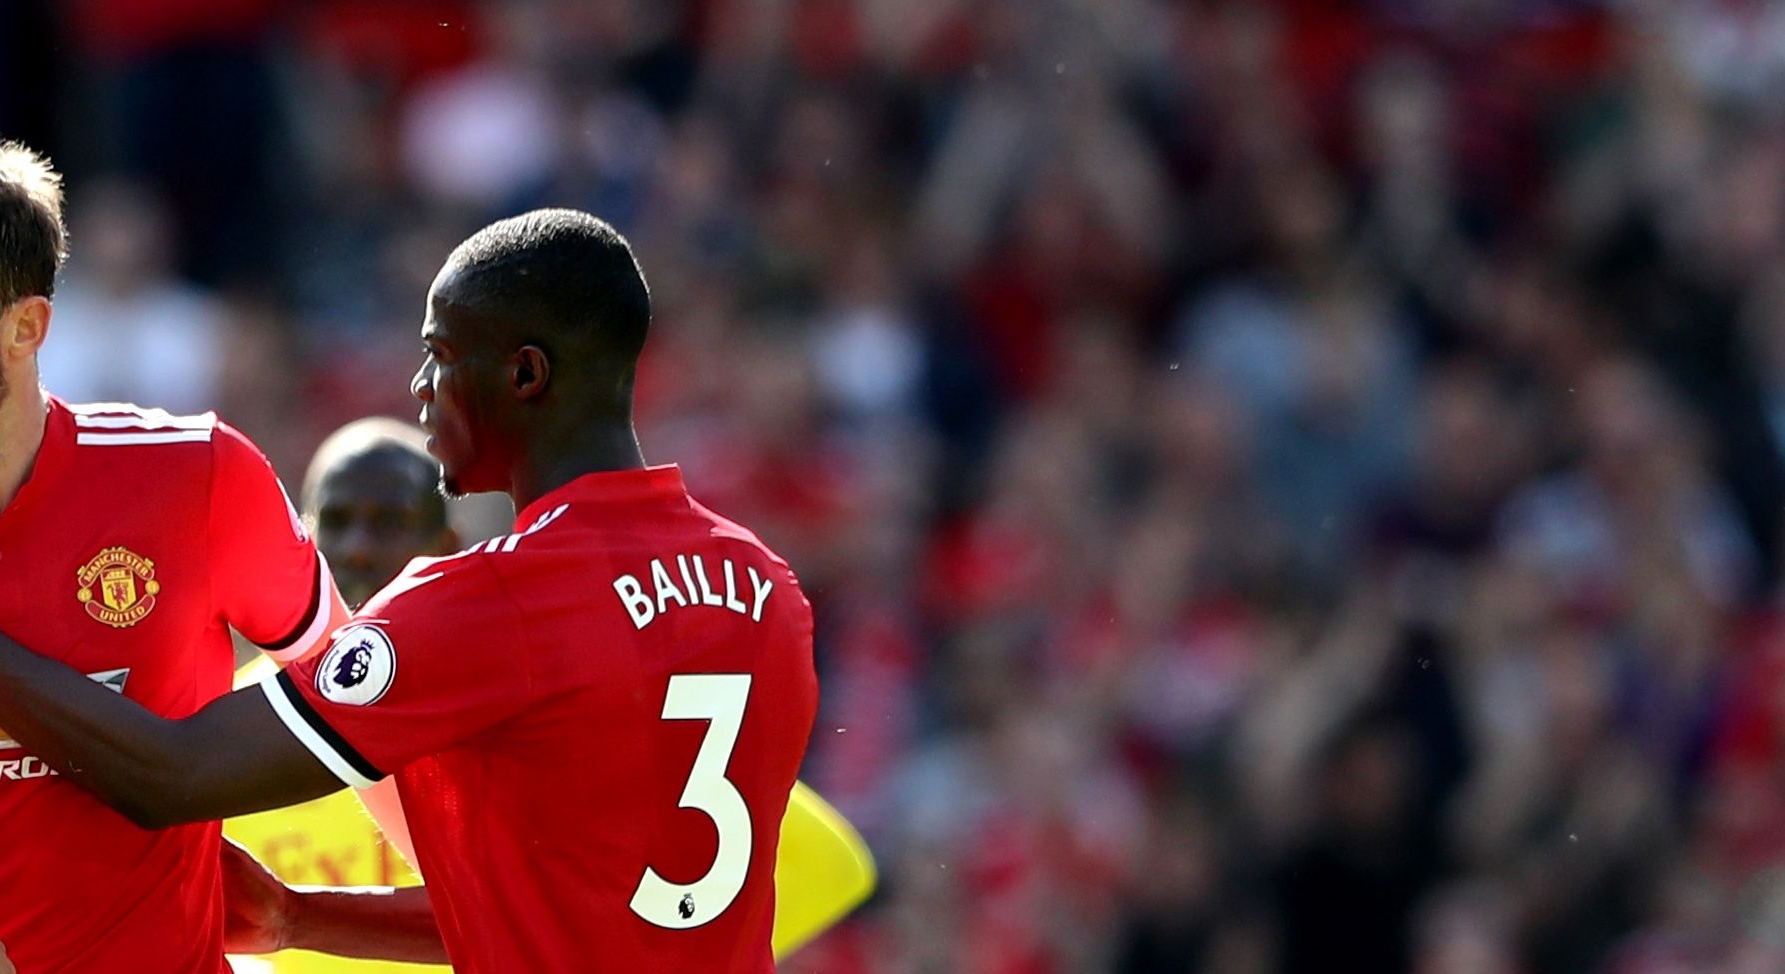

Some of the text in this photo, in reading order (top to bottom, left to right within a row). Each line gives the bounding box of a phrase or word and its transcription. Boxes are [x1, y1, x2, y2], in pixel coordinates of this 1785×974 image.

[83, 552, 150, 582] MANCHESTER
[613, 554, 774, 630] BAILLY
[99, 606, 146, 622] UNITED
[629, 674, 753, 930] 3
